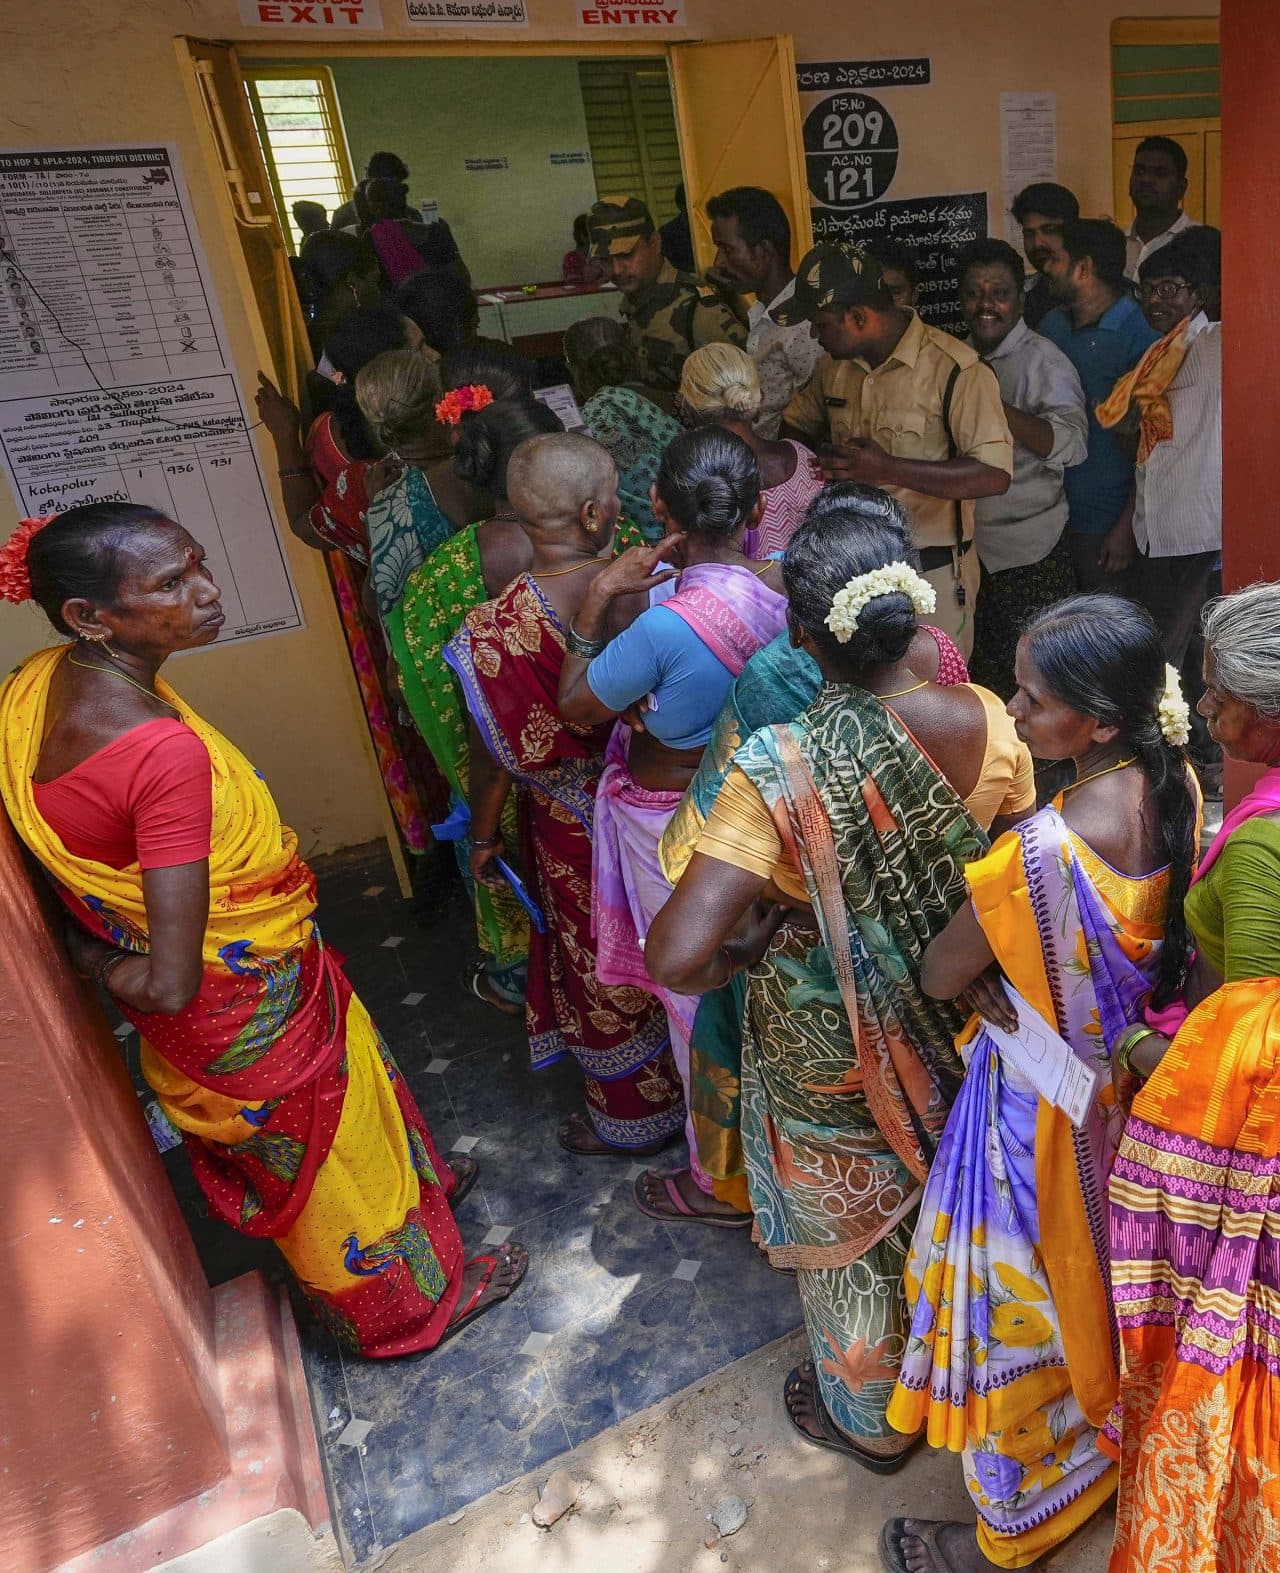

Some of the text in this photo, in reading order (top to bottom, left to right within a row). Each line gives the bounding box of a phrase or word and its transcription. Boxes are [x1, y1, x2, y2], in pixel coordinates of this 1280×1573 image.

[258, 5, 365, 25] EXIT
[582, 10, 679, 25] ENTRY
[836, 65, 926, 87] ఎన్నికలు-2024
[822, 111, 884, 150] 209
[92, 154, 128, 164] TIRUPATI
[130, 153, 166, 163] DISTRICT
[3, 172, 27, 181] FORM
[824, 167, 875, 201] 121
[50, 384, 186, 407] సాధారణ ఎన్నికలు-2024
[24, 409, 75, 422] పోలింగు
[175, 391, 215, 405] నోటీసు
[17, 452, 61, 464] పోలింగు
[210, 457, 232, 468] 931
[167, 463, 194, 475] 936
